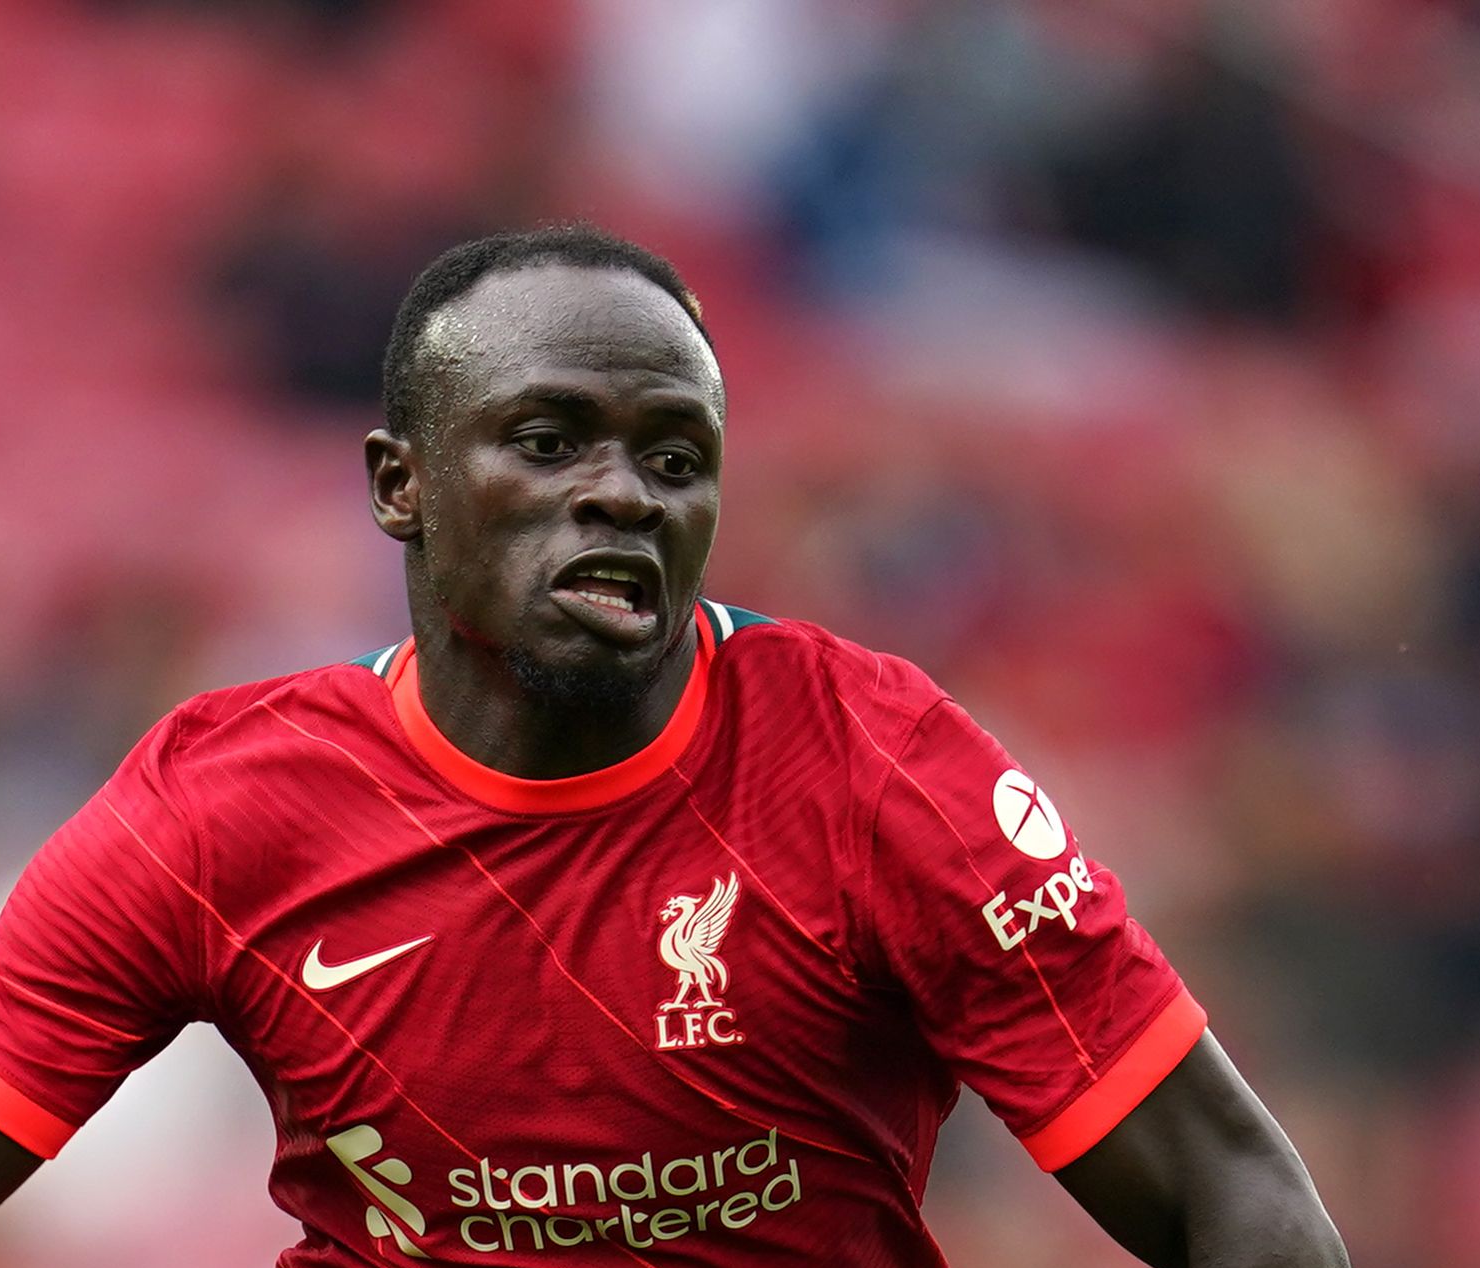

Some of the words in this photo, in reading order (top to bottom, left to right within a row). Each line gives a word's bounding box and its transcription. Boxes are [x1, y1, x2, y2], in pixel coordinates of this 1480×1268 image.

[981, 850, 1095, 951] Expe
[656, 1010, 744, 1048] L.F.C.
[447, 1125, 778, 1210] standard
[459, 1158, 802, 1253] chartered
